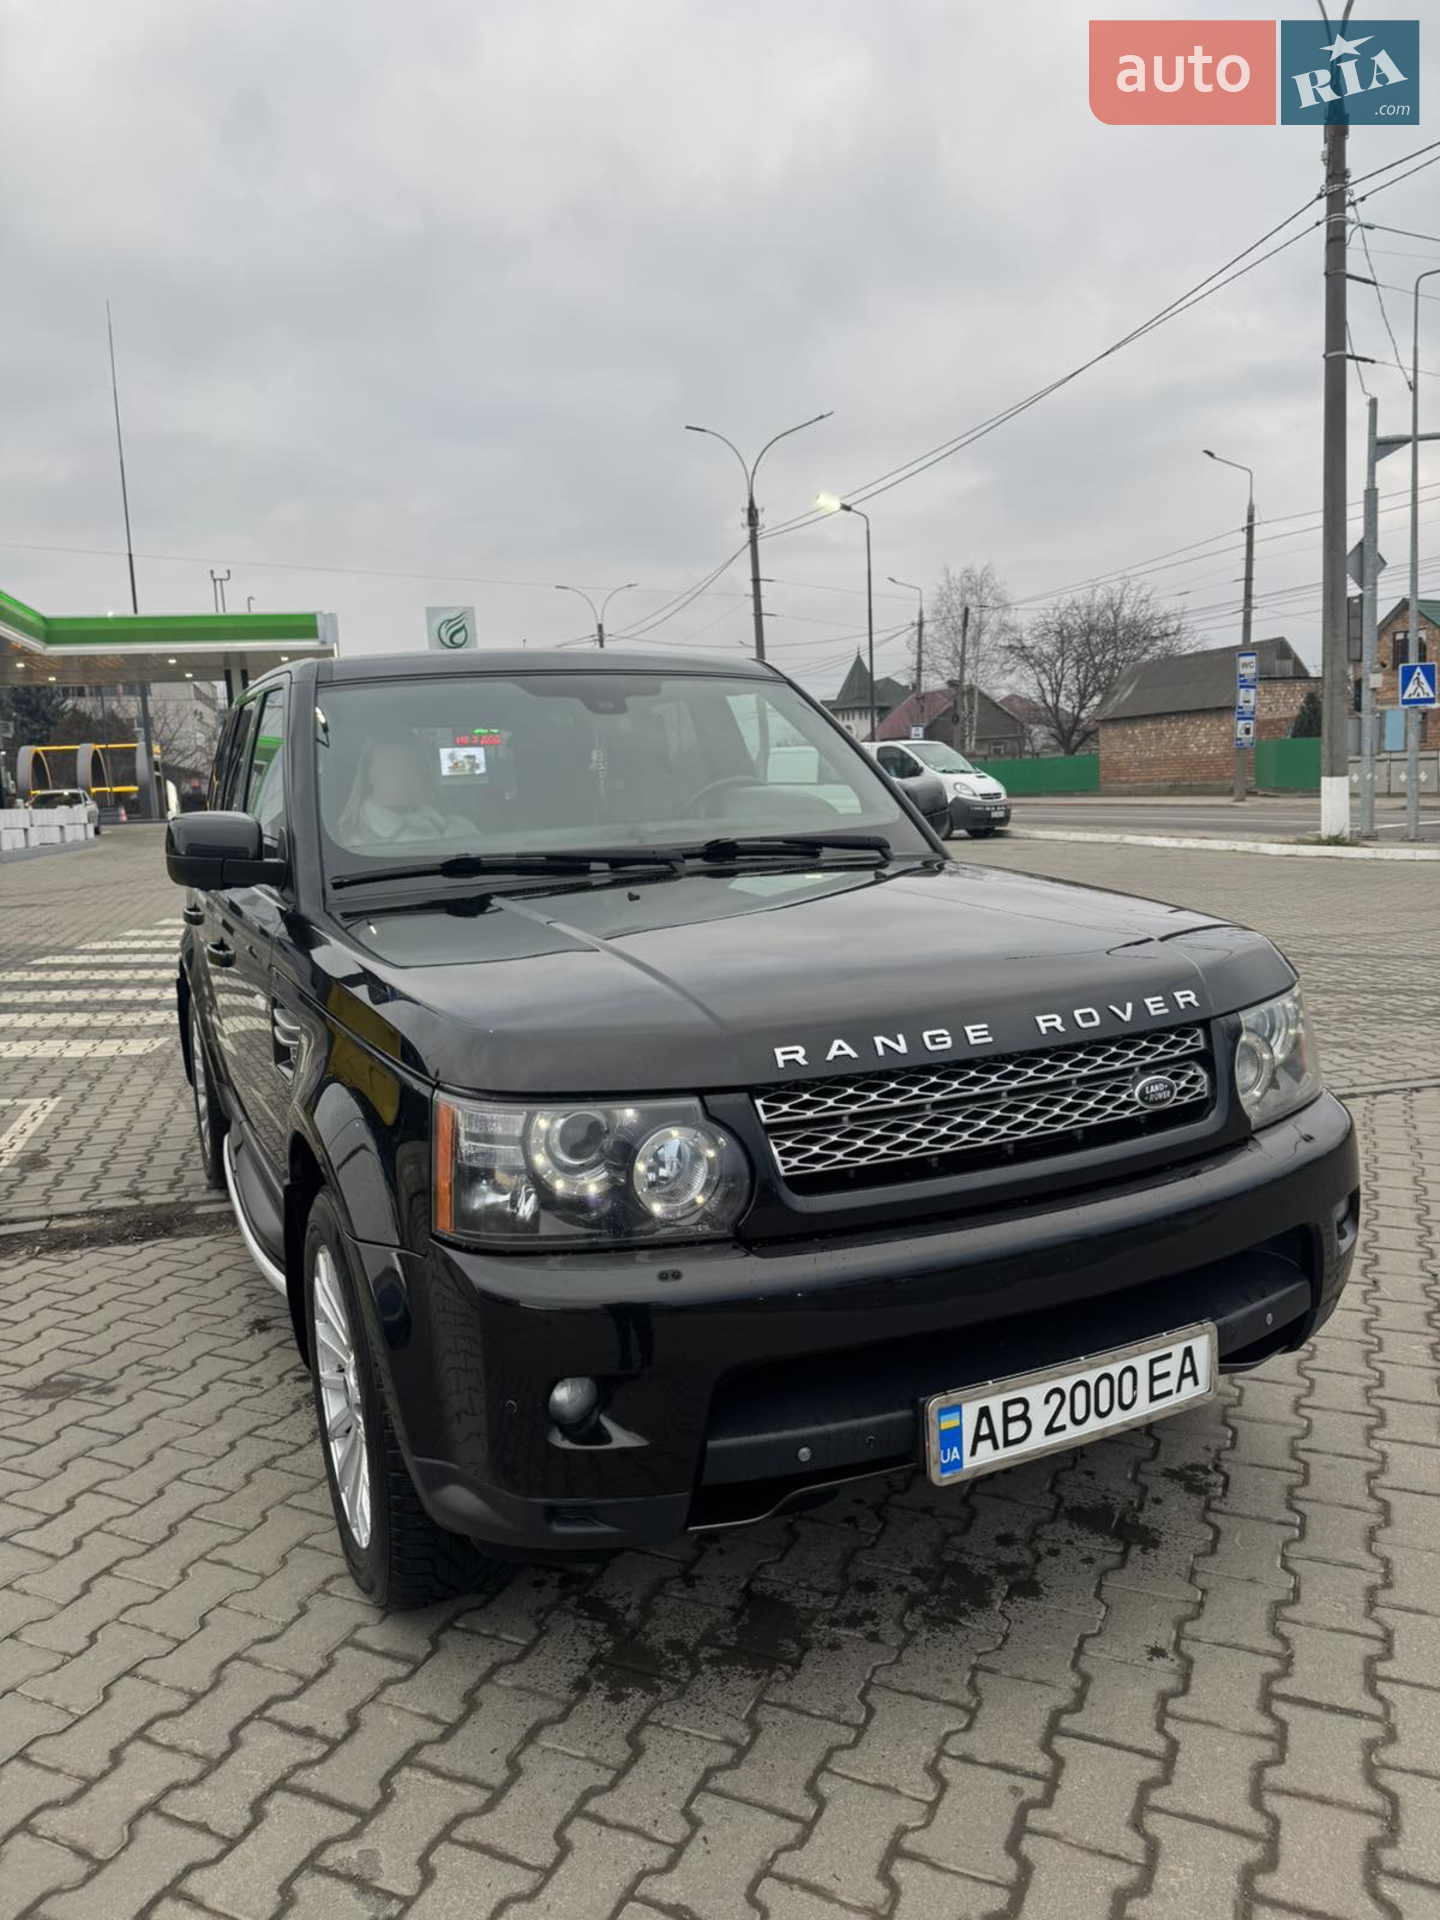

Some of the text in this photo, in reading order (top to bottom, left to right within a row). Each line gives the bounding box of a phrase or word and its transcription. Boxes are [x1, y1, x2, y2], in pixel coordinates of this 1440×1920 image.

[1240, 661, 1255, 669] WC
[773, 989, 1200, 1069] RANGE ROVER
[1145, 1083, 1165, 1094] LAND
[969, 1345, 1200, 1458] AB 2000 EA
[940, 1446, 961, 1464] UA
